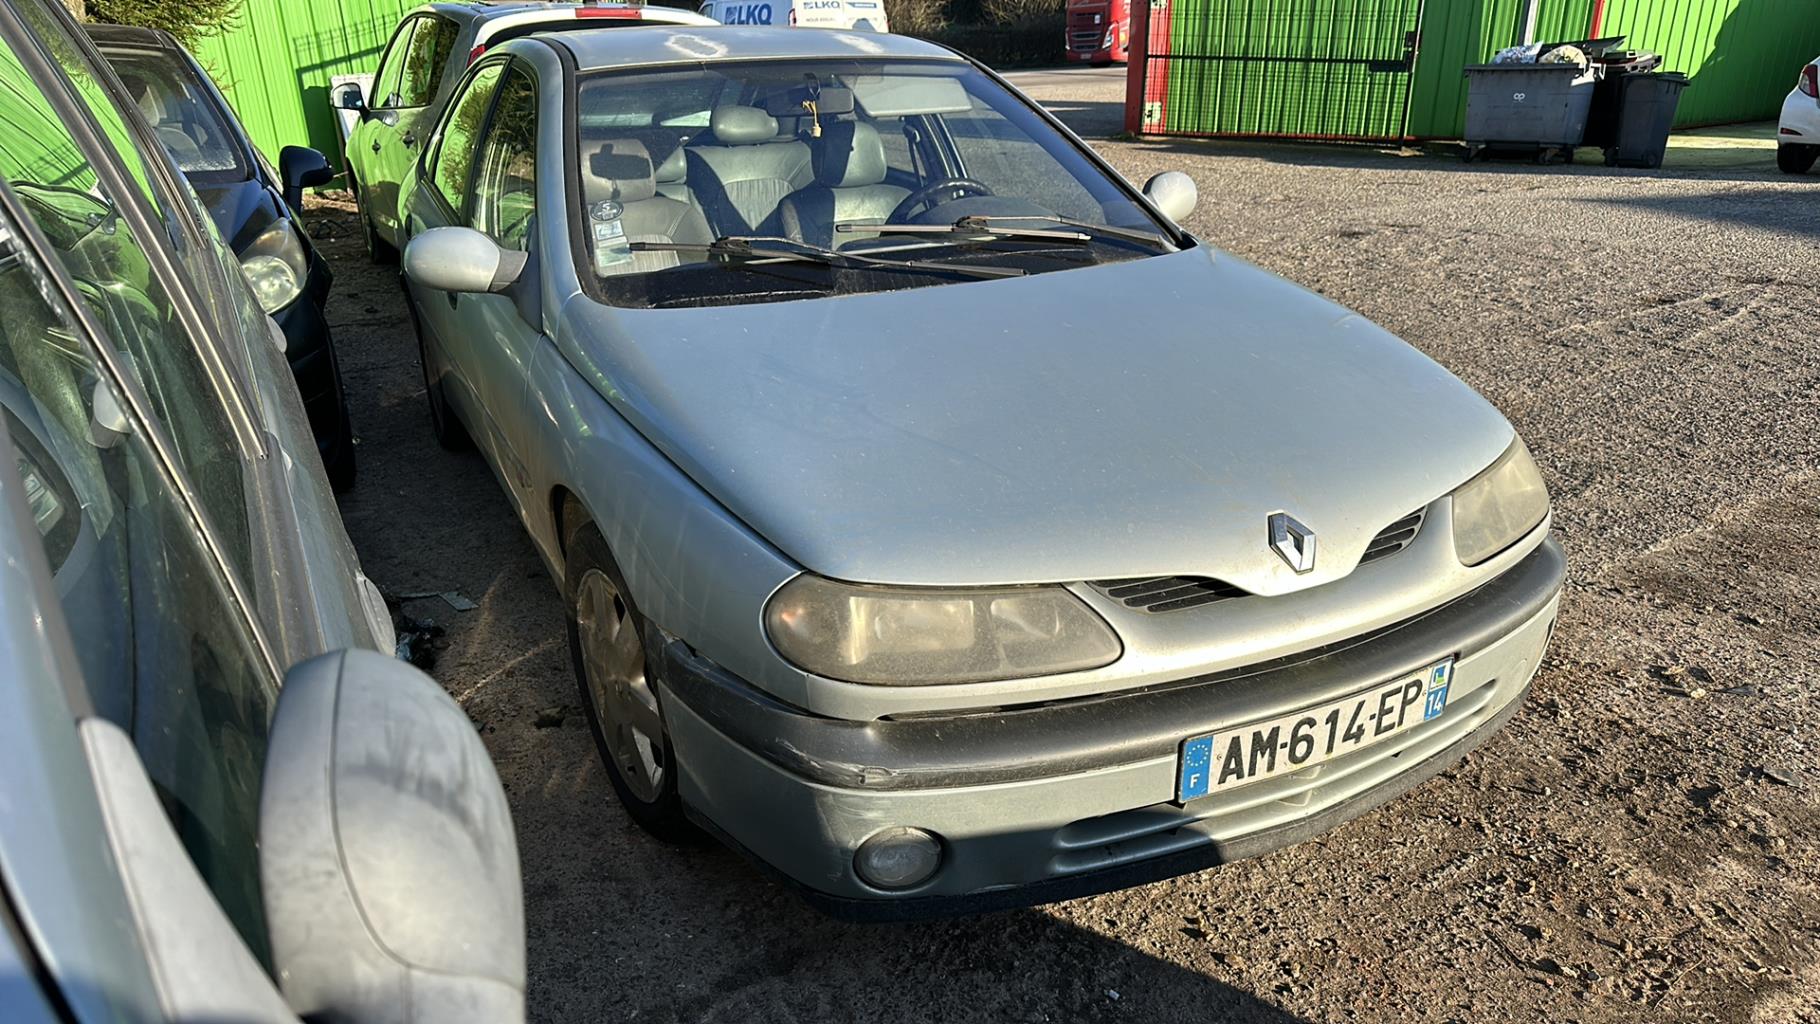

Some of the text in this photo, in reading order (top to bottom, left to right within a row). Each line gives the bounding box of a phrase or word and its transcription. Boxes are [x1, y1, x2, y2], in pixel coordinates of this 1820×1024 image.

[737, 3, 772, 25] LKQ
[815, 1, 840, 9] LKQ
[1428, 690, 1443, 715] 14
[1218, 679, 1423, 785] AM-614-EP
[1189, 774, 1200, 788] F
